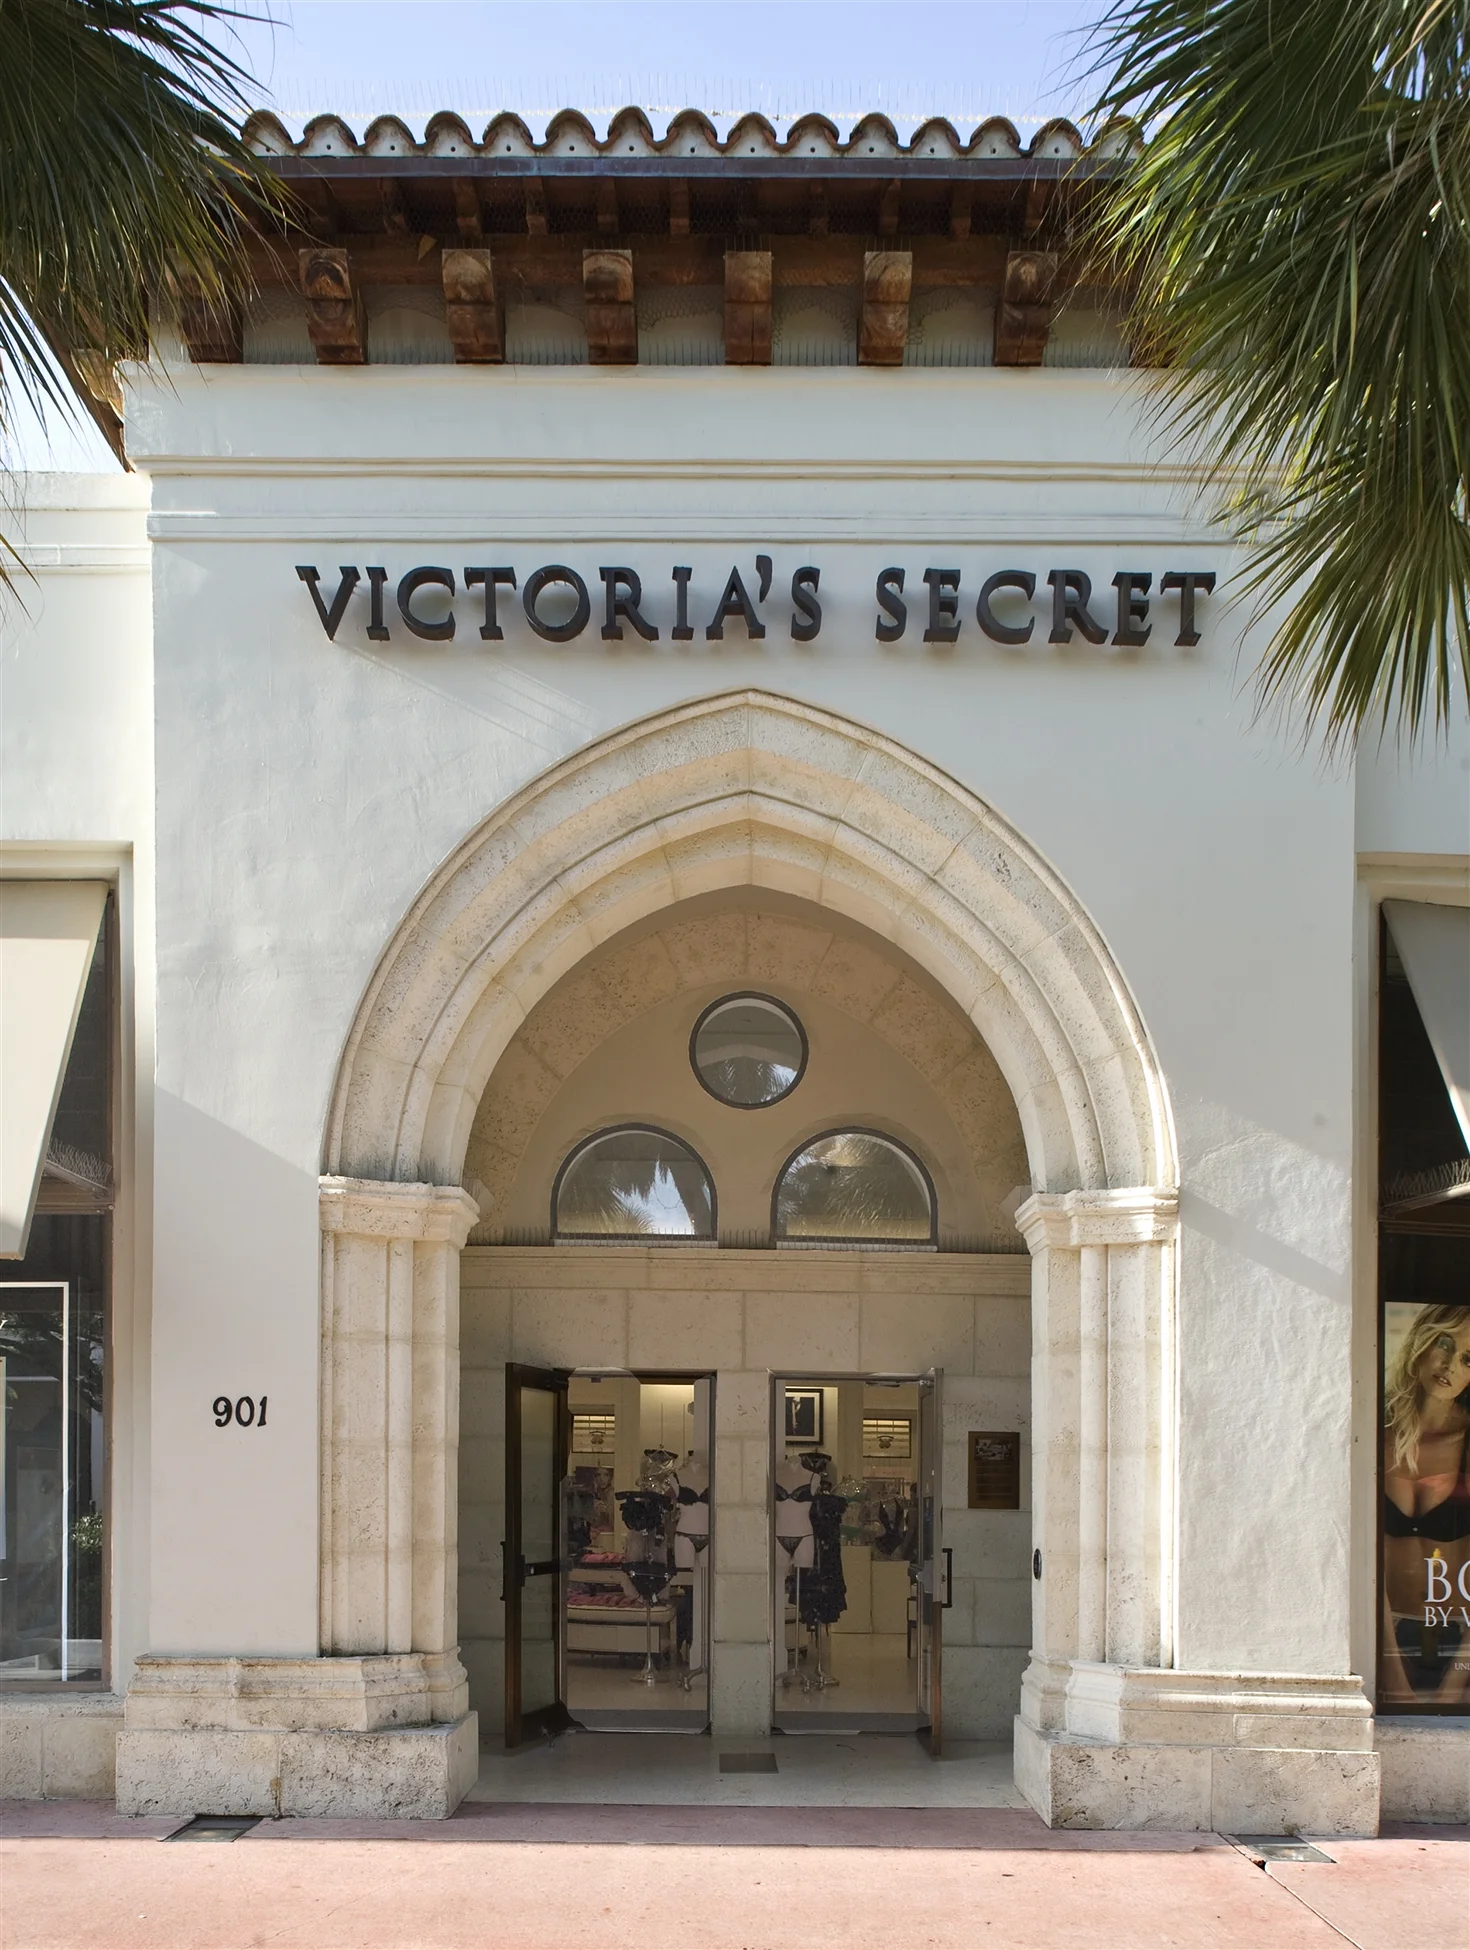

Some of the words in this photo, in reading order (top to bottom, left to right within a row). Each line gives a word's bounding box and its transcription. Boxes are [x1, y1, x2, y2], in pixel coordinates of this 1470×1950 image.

[295, 555, 822, 641] VICTORIA'S
[876, 566, 1216, 646] SECRET
[213, 1396, 267, 1427] 901
[1424, 1606, 1453, 1628] BY
